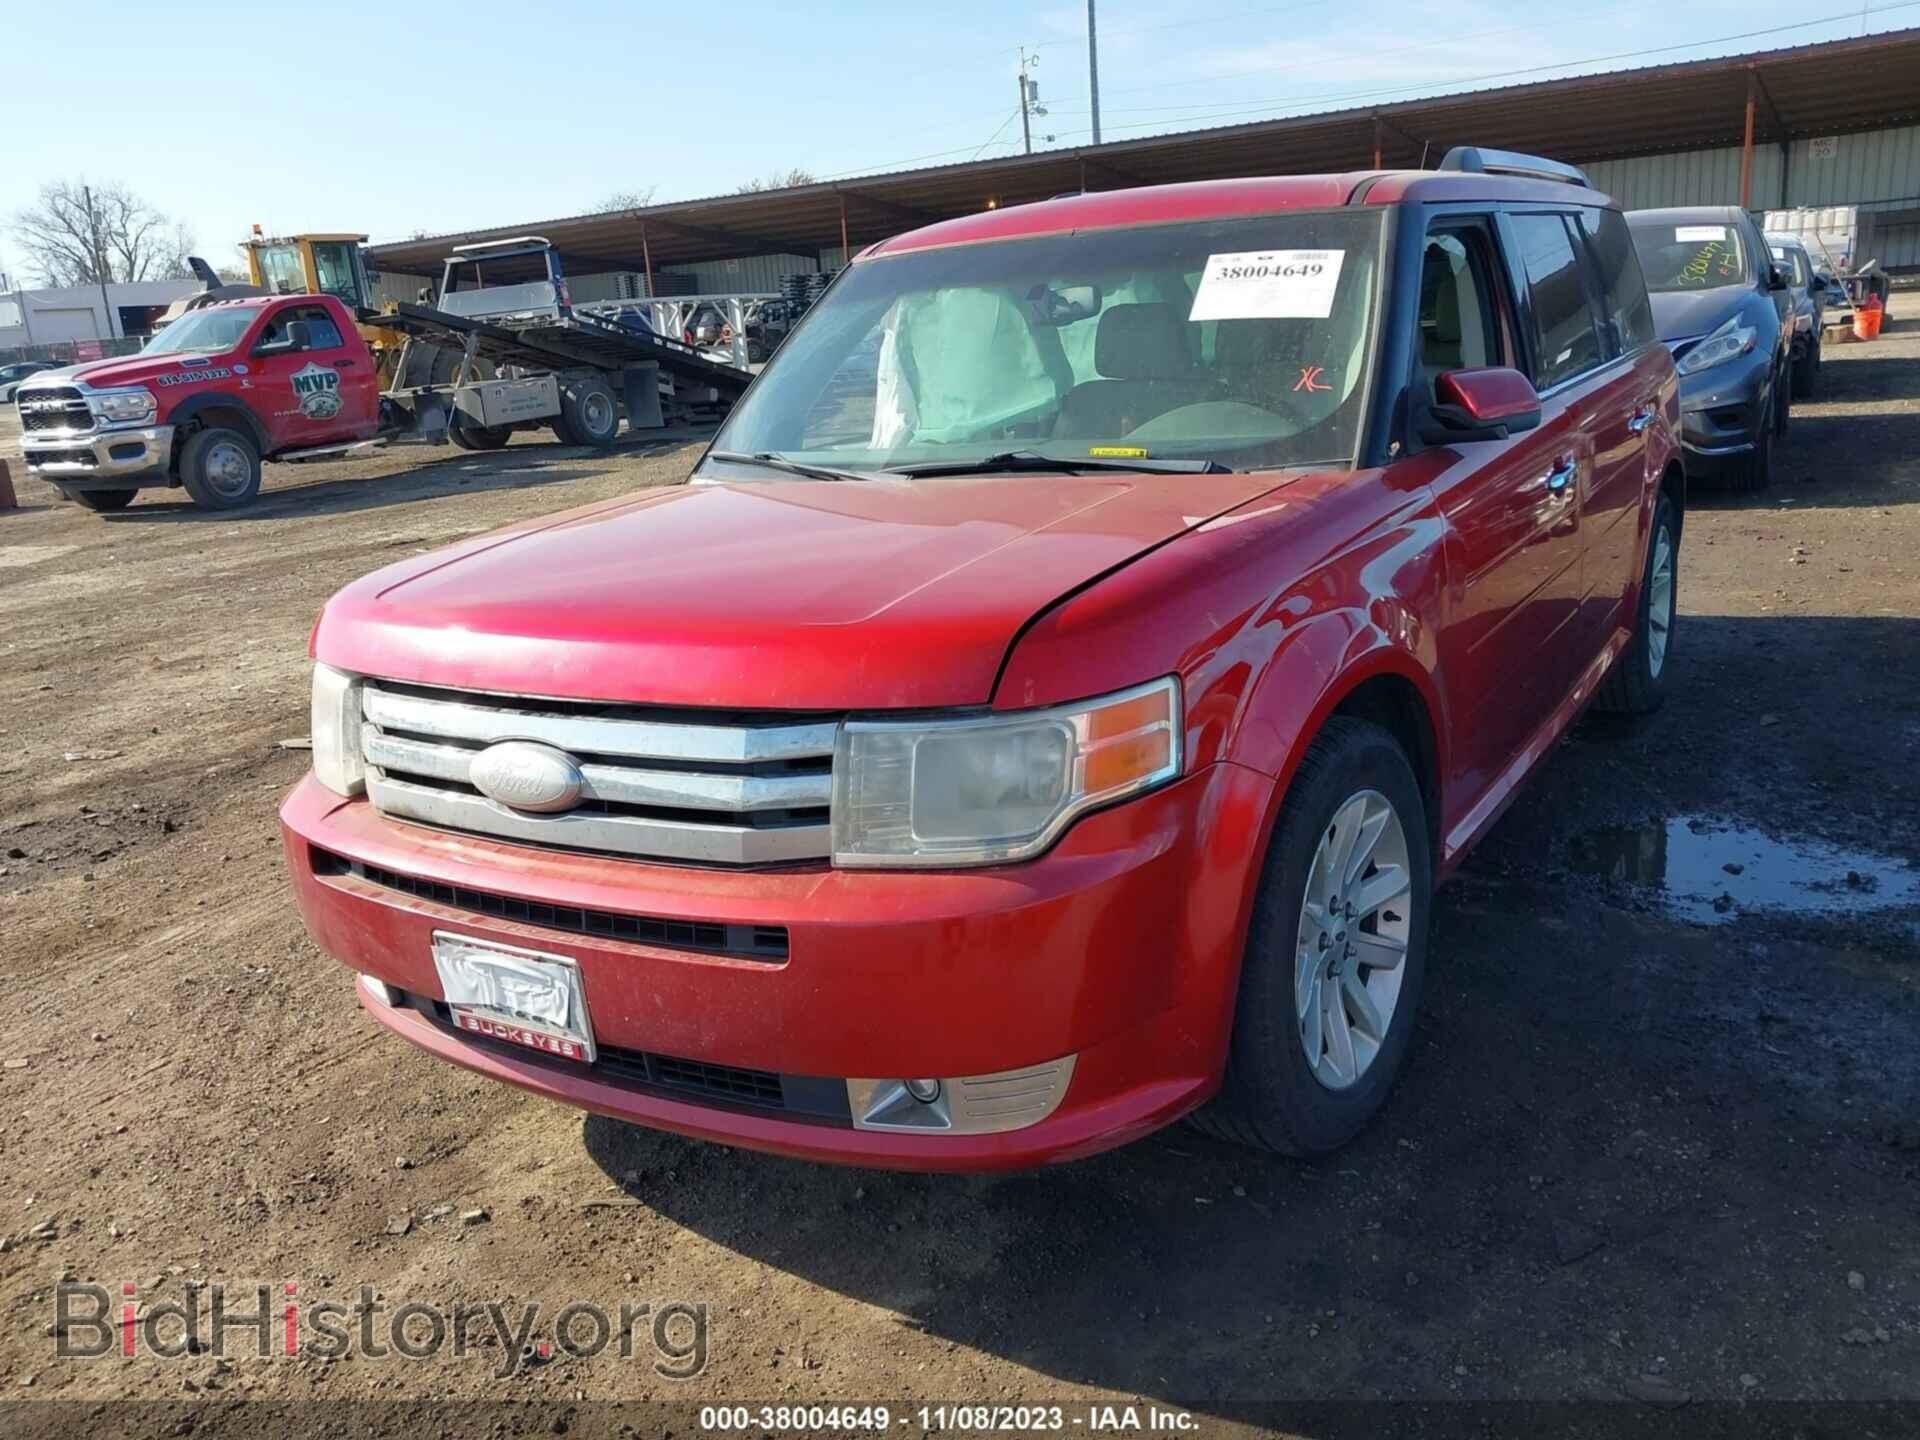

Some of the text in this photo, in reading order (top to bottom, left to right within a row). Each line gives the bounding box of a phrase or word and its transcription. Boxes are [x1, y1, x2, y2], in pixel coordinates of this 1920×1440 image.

[1216, 263, 1324, 281] 38004649
[293, 372, 338, 393] MVP
[486, 758, 545, 796] Ford
[466, 1017, 576, 1056] BUCKEYES
